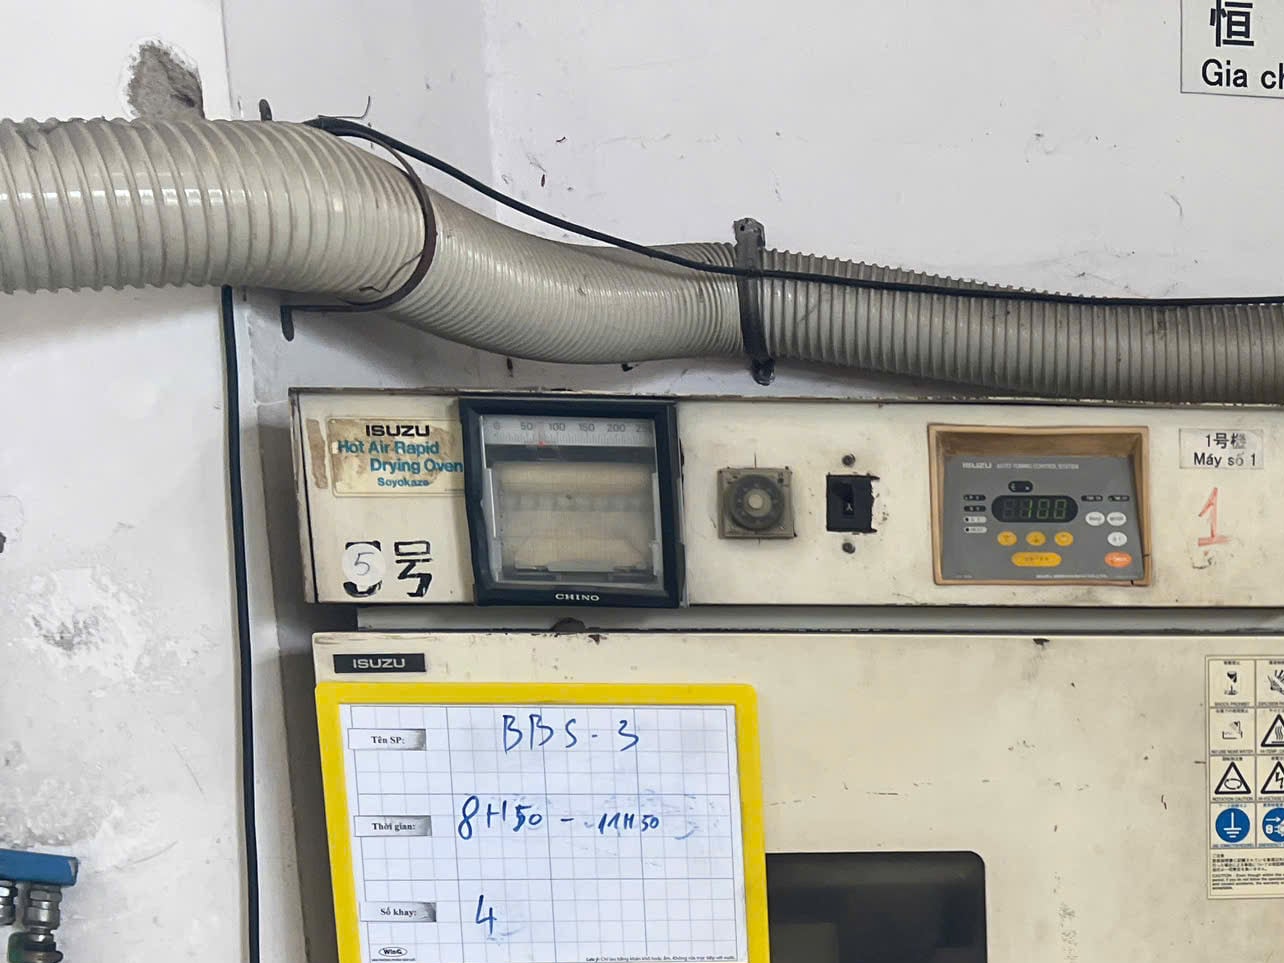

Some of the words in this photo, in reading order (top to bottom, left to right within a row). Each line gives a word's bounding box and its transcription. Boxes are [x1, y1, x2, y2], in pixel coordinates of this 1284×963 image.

[1201, 58, 1248, 88] Gia
[365, 425, 430, 437] ISUZU
[520, 422, 534, 430] 50
[338, 440, 365, 453] Hot
[368, 441, 390, 454] Air
[394, 441, 440, 457] Rapid
[370, 458, 421, 474] Drying
[423, 458, 463, 472] Oven
[1193, 452, 1222, 468] Máy
[1227, 452, 1245, 466] số
[1250, 453, 1256, 466] 1
[1198, 487, 1231, 546] 1
[555, 593, 600, 601] CHINO
[352, 658, 406, 669] ISUZU
[370, 735, 388, 744] Tên
[393, 908, 416, 917] khay:
[475, 894, 497, 936] 4
